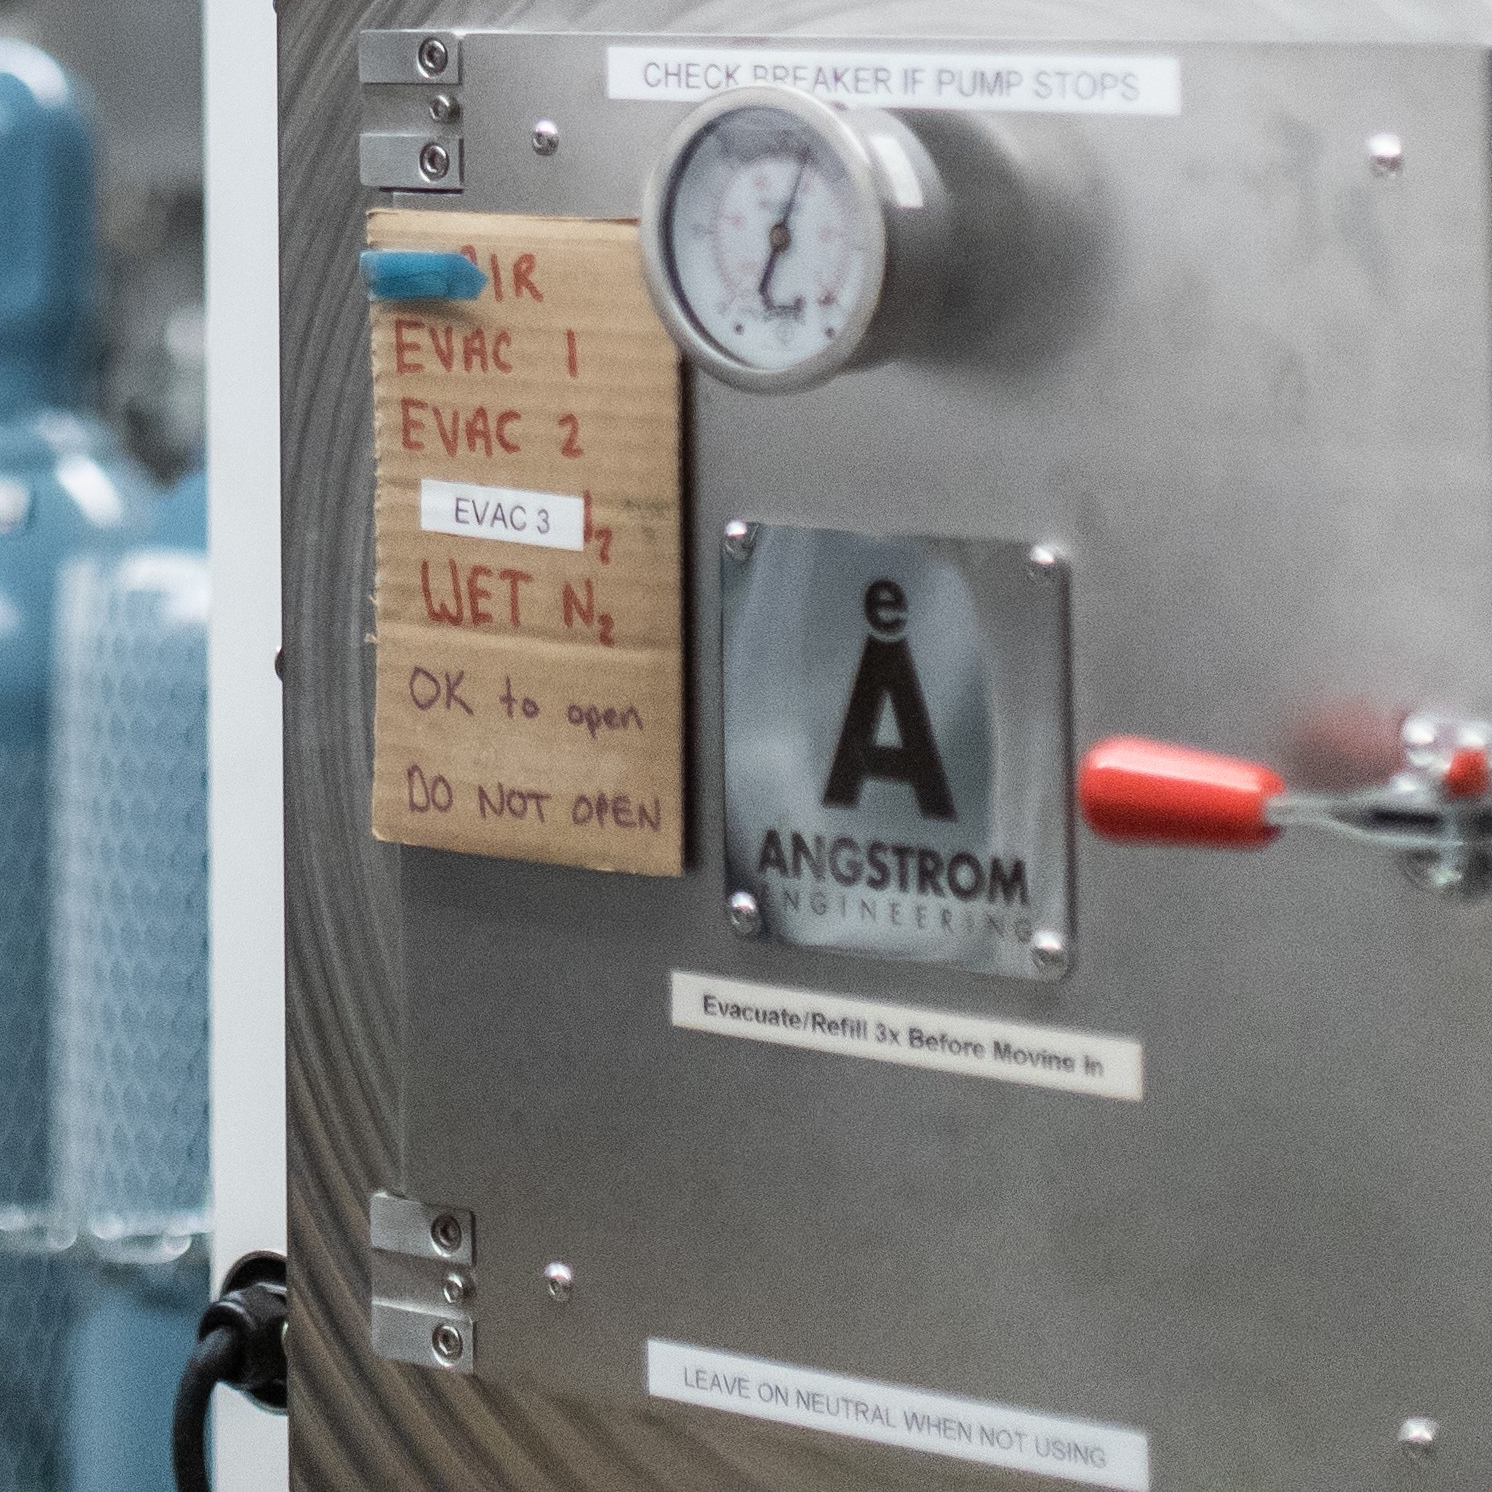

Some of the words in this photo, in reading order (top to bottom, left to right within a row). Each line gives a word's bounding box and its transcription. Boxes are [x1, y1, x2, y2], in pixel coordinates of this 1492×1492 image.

[643, 61, 741, 90] CHECK
[753, 64, 893, 95] BREAKER
[902, 68, 925, 96] IF
[936, 69, 1023, 97] PUMP
[1034, 70, 1141, 102] STOPS
[460, 244, 544, 303] IR
[394, 318, 513, 374] EVAC
[566, 328, 578, 378] 1
[399, 396, 521, 458] EVAC
[557, 413, 584, 459] 2
[454, 496, 528, 532] EVAC
[536, 508, 551, 535] 3
[419, 558, 535, 629] WET
[863, 578, 909, 633] e
[409, 667, 474, 716] OK
[498, 674, 541, 719] to
[567, 703, 643, 740] open
[822, 634, 958, 822] A
[407, 763, 454, 814] DO
[477, 781, 552, 823] NOT
[571, 790, 662, 832] OPEN
[757, 829, 1031, 908] ANGSTROM
[703, 993, 867, 1040] Evacuate/Refill
[874, 1022, 902, 1047] 3x
[908, 1027, 986, 1059] Before
[993, 1041, 1076, 1074] Moving
[683, 1366, 752, 1400] LEAVE
[757, 1382, 789, 1407] ON
[796, 1389, 897, 1429] NEUTRAL
[903, 1410, 973, 1444] WHEN
[979, 1425, 1026, 1454] NOT
[1035, 1436, 1108, 1469] USING
